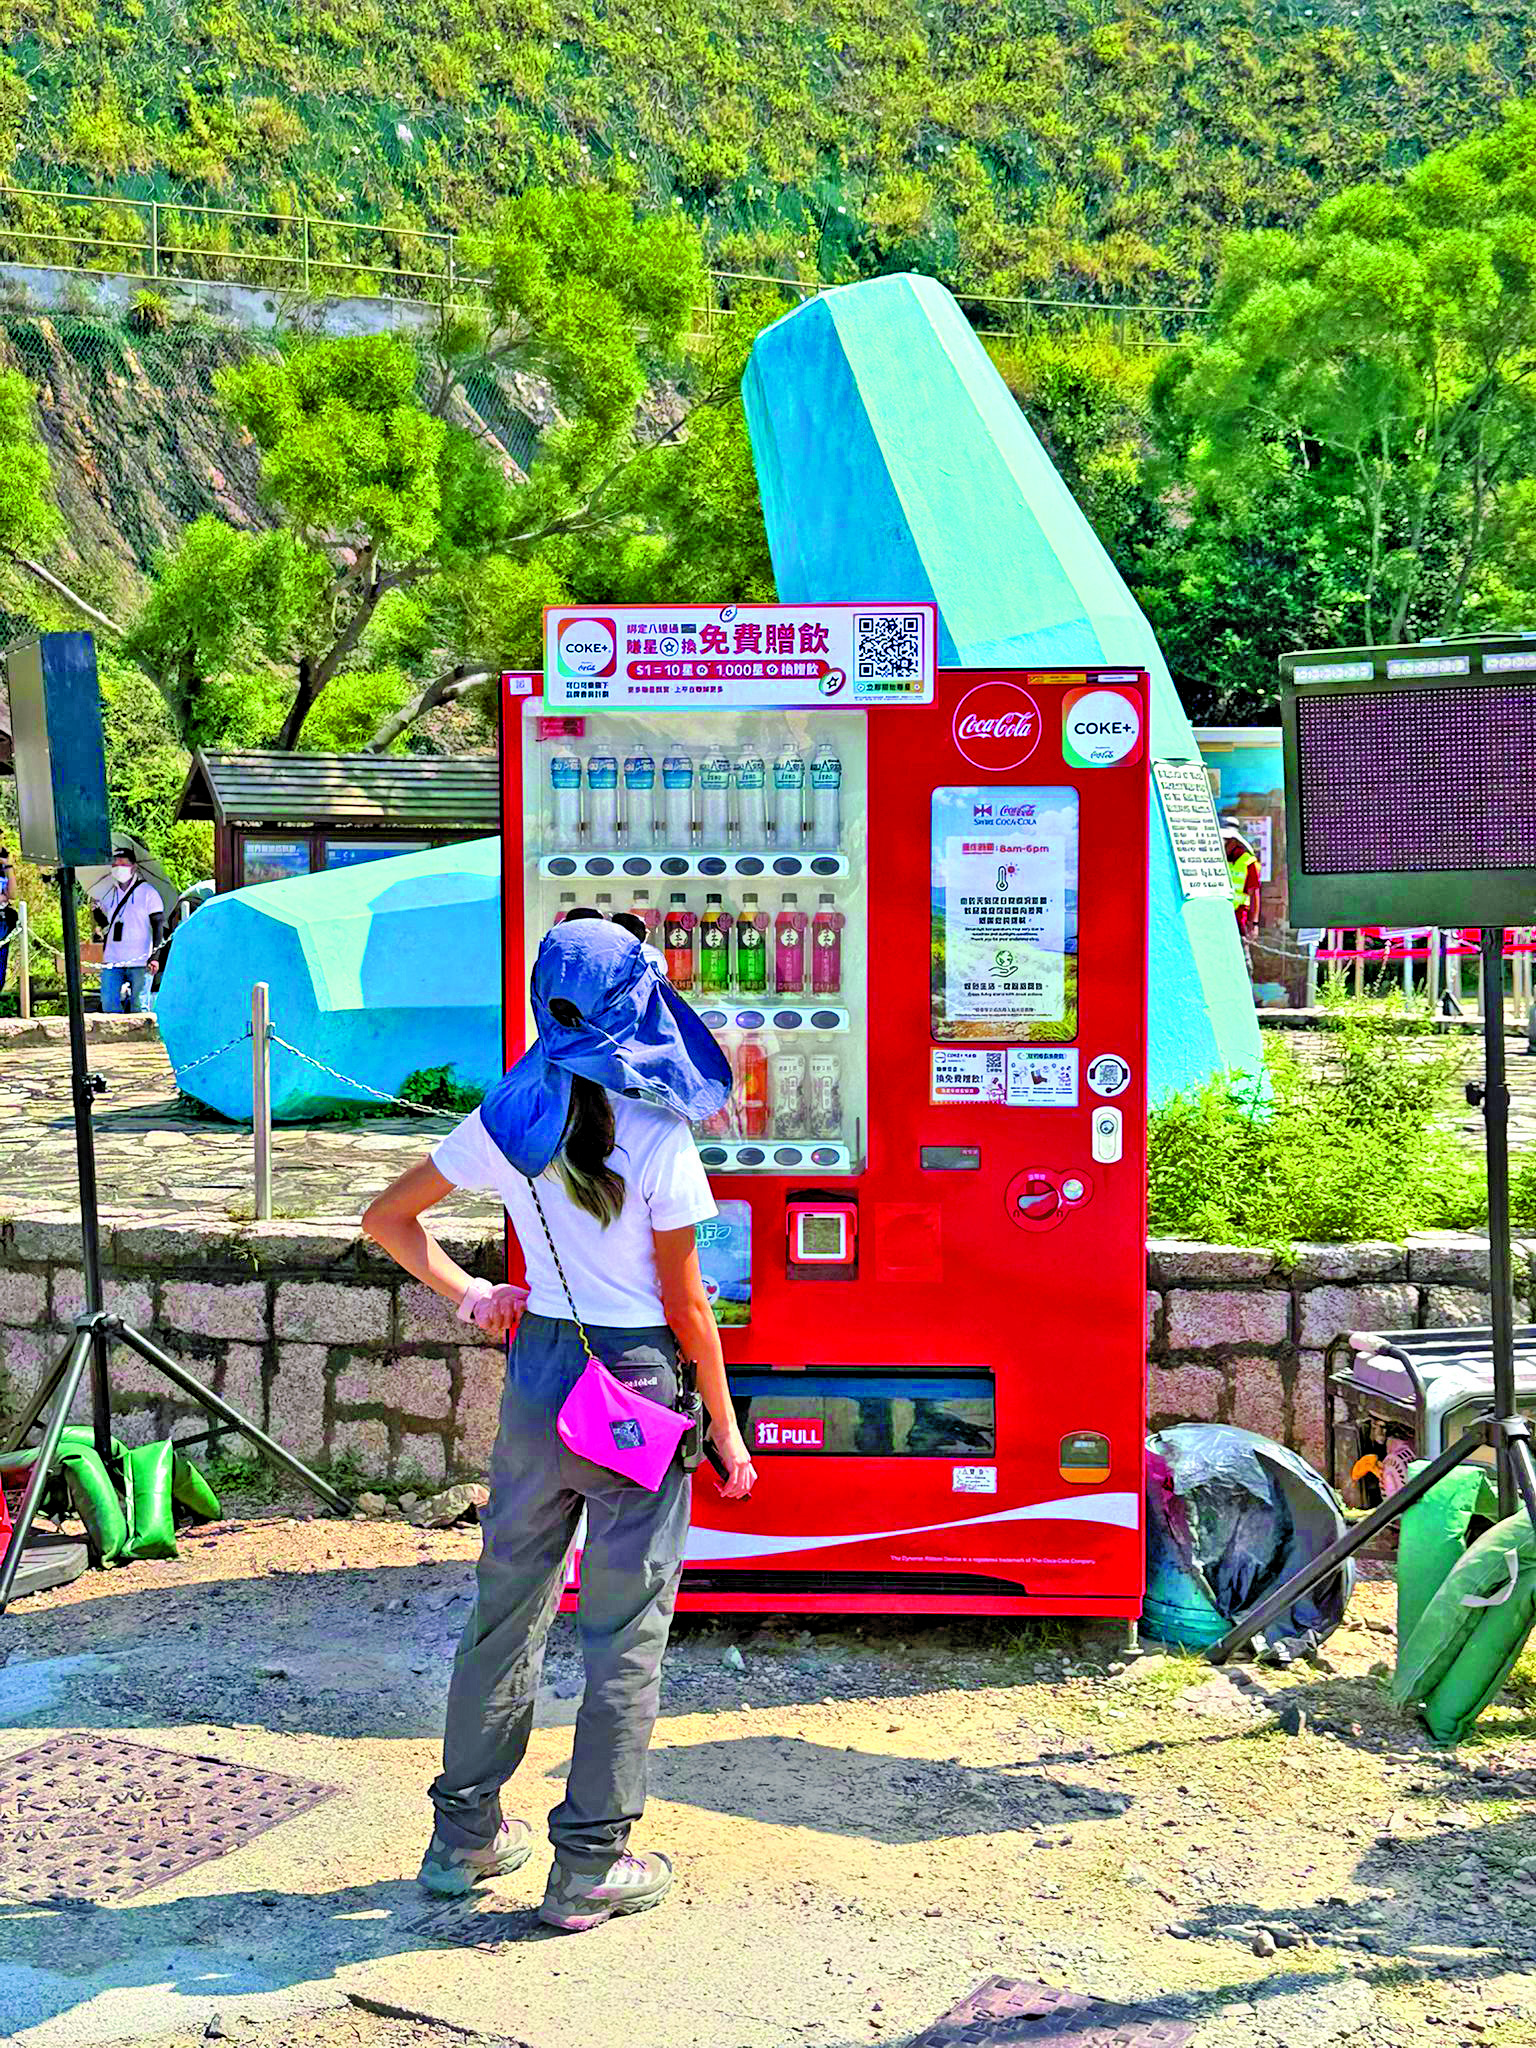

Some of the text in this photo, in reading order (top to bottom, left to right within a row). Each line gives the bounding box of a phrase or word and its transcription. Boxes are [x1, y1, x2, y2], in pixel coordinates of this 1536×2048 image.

[699, 622, 830, 655] 免費贈飲
[958, 712, 1036, 740] Coca-Cola
[1000, 804, 1037, 817] Coca-Cola
[996, 818, 1037, 826] COCA-COLA
[758, 1422, 821, 1444] 拉 PULL
